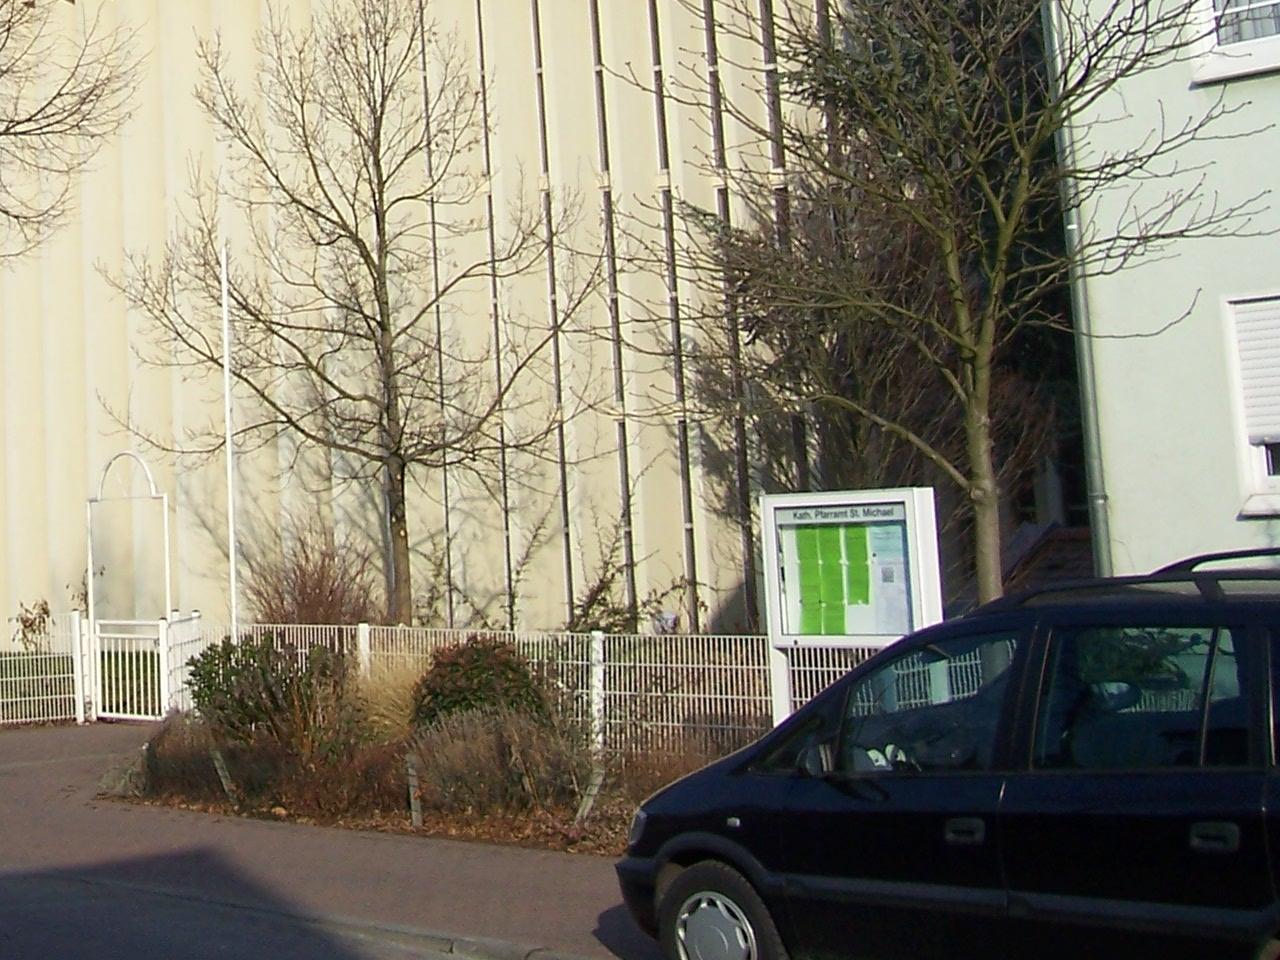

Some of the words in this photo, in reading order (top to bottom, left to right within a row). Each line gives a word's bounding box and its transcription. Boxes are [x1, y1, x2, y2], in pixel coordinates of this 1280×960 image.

[792, 510, 812, 520] Kath.
[814, 509, 848, 519] Pfarramt
[849, 508, 861, 519] St.
[862, 507, 895, 518] Michael
